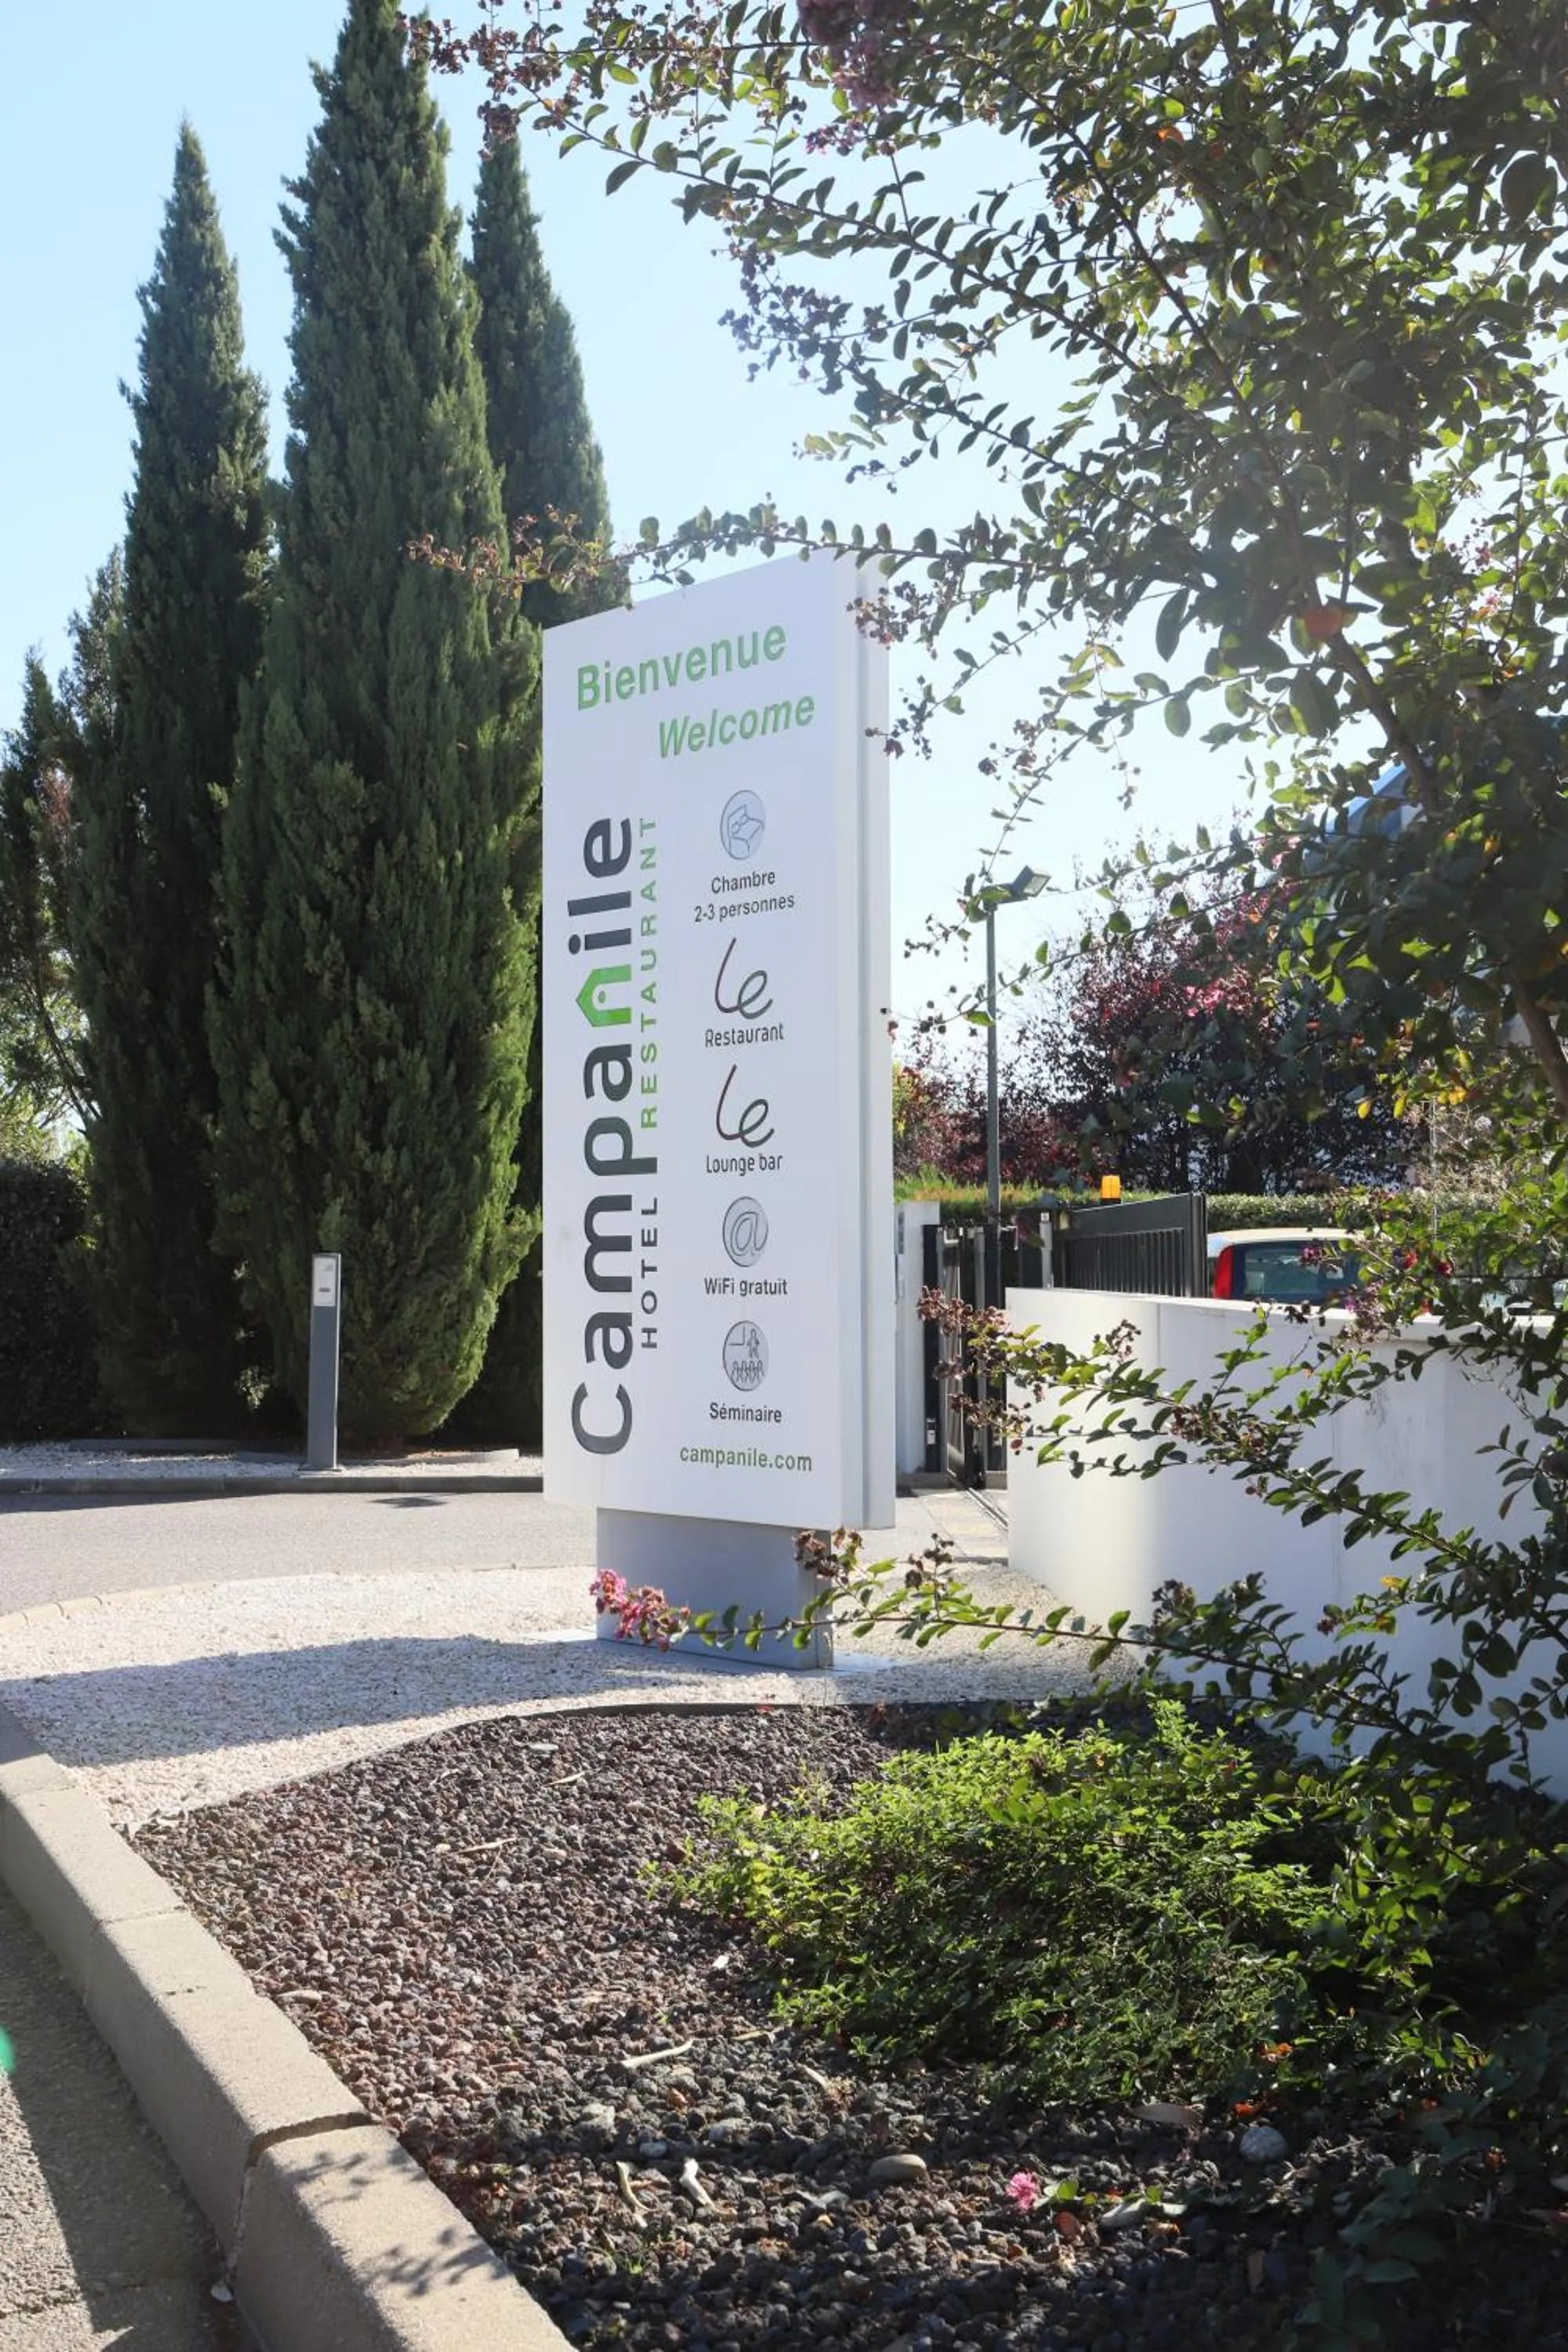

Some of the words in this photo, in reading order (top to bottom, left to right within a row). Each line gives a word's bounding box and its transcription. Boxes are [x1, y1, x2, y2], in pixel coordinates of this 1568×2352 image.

[577, 625, 786, 710] Bienvenue
[659, 695, 815, 758] Welcome
[711, 871, 775, 894] Chambre
[695, 902, 715, 922] 2-3
[720, 895, 794, 921] personnes
[640, 818, 658, 1129] RESTAURANT
[705, 1023, 784, 1047] Restaurant
[568, 817, 657, 1456] Campanile
[706, 1155, 755, 1176] Lounge
[759, 1153, 783, 1171] bar
[641, 1197, 658, 1349] HOTEL
[704, 1277, 735, 1294] WiFi
[739, 1278, 788, 1298] gratuit
[710, 1401, 782, 1424] Séminaire
[680, 1446, 812, 1472] campanile.com
